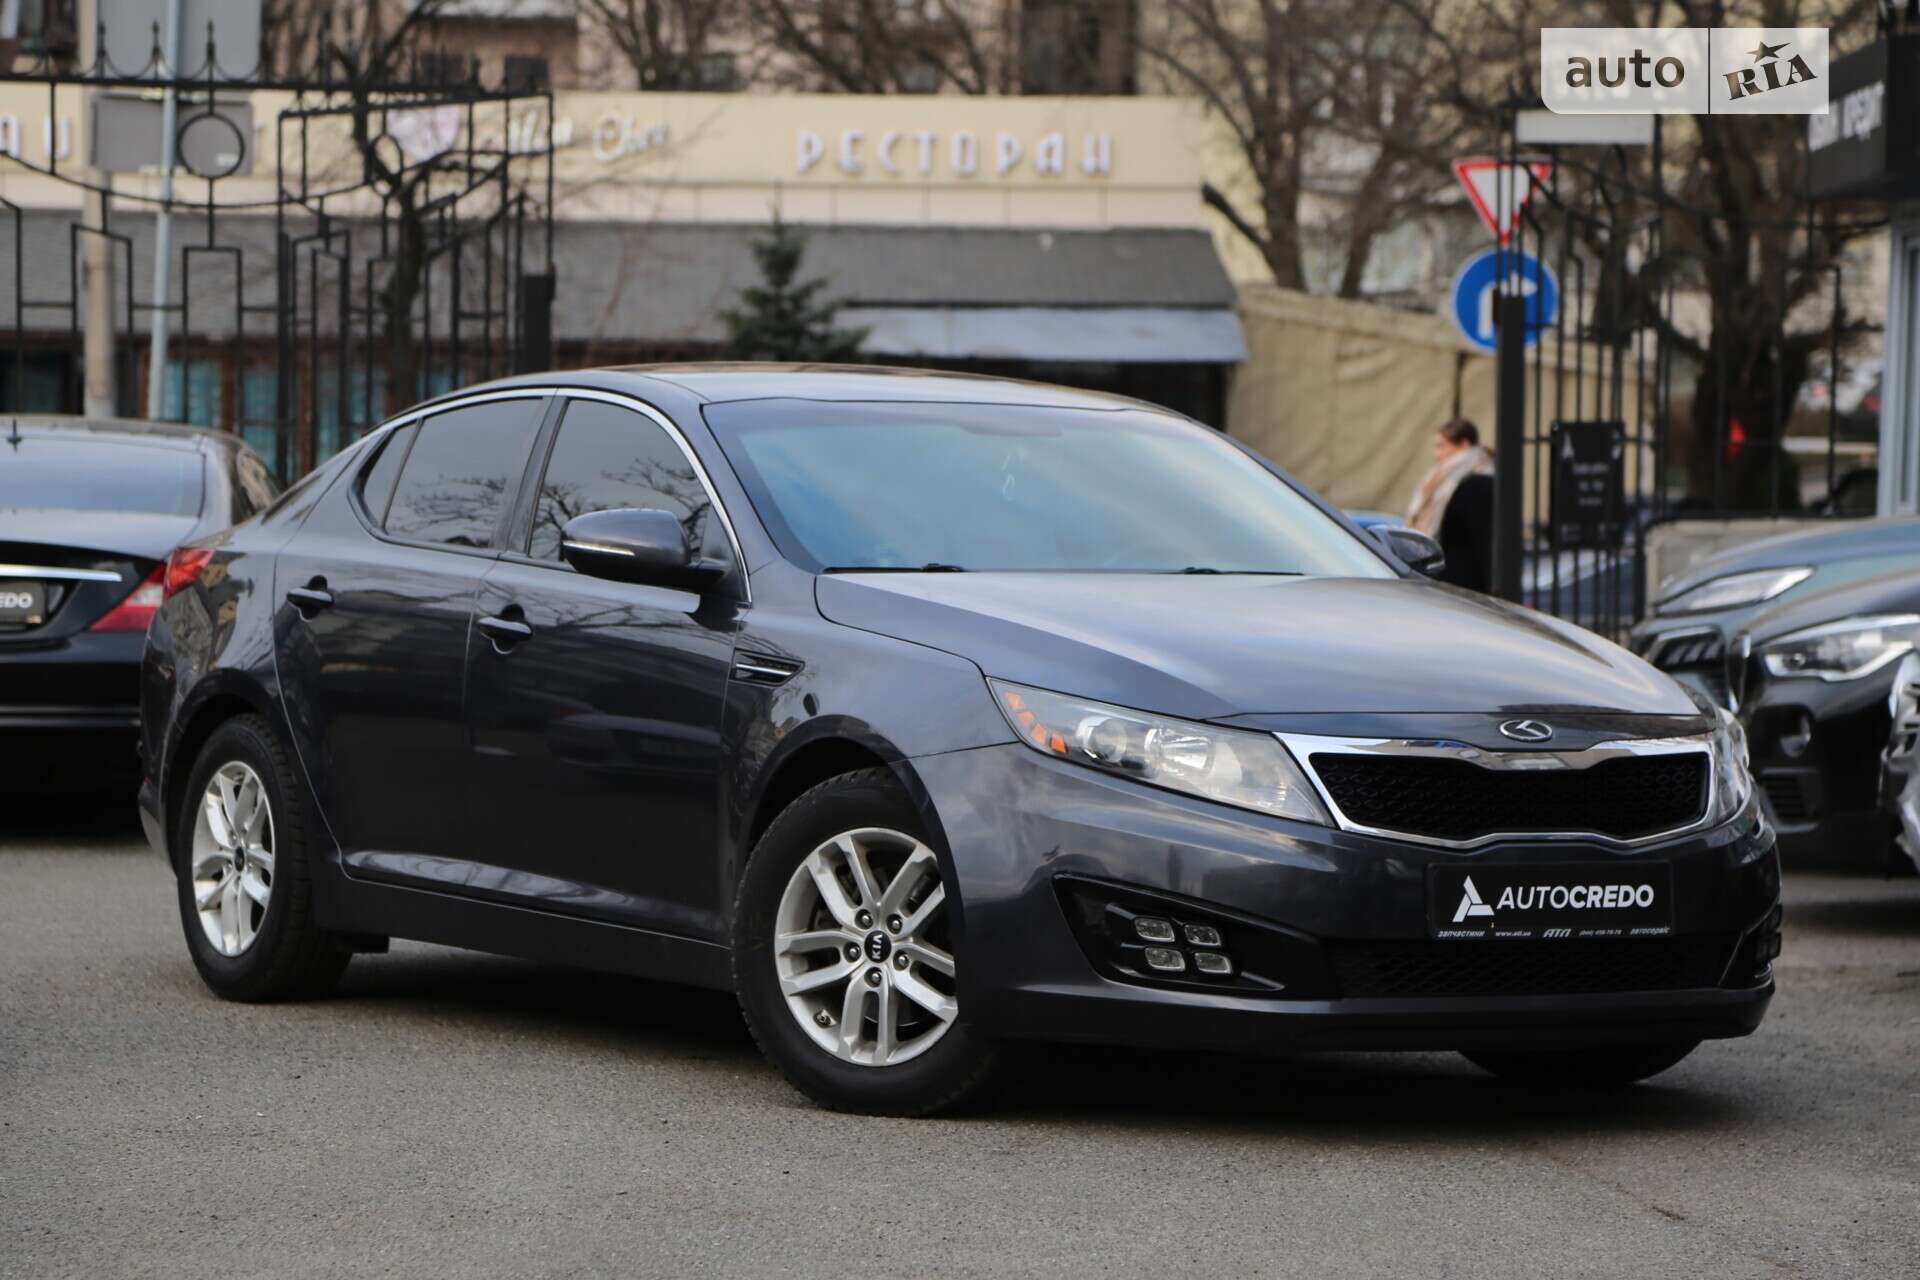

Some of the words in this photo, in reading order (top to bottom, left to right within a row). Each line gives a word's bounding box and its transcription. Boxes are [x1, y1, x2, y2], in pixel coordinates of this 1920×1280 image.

[797, 130, 1114, 176] РЕСТОРАН
[1496, 883, 1655, 911] AUTOCREDO
[872, 934, 883, 960] KIA
